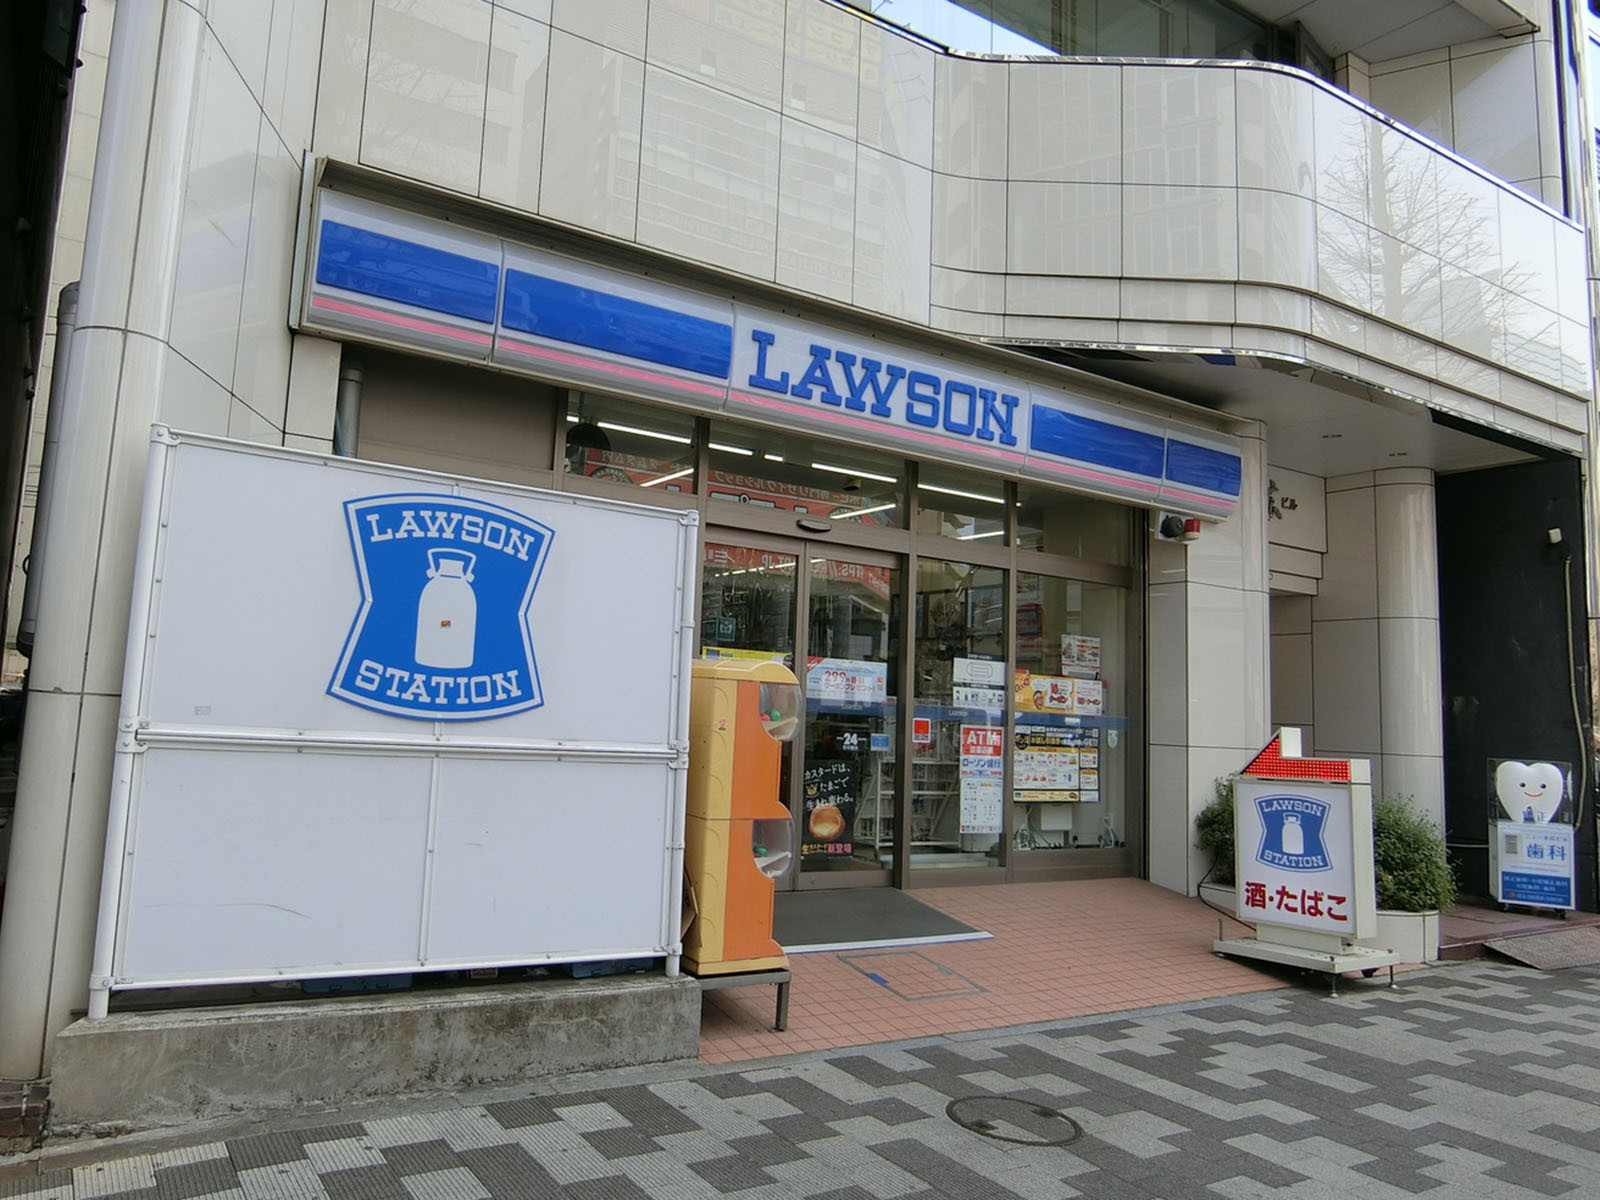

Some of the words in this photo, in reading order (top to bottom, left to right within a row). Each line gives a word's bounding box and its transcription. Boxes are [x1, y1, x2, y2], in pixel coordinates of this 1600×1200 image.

[748, 329, 1020, 446] LAWSON
[366, 510, 535, 561] LAWSON
[355, 659, 521, 704] STATION
[843, 733, 858, 745] 24
[967, 731, 1001, 746] ATM
[1262, 800, 1324, 816] LAWSON
[1263, 850, 1324, 867] STATION
[1526, 843, 1566, 861] 歯科
[1245, 881, 1348, 921] 酒・たばこ
